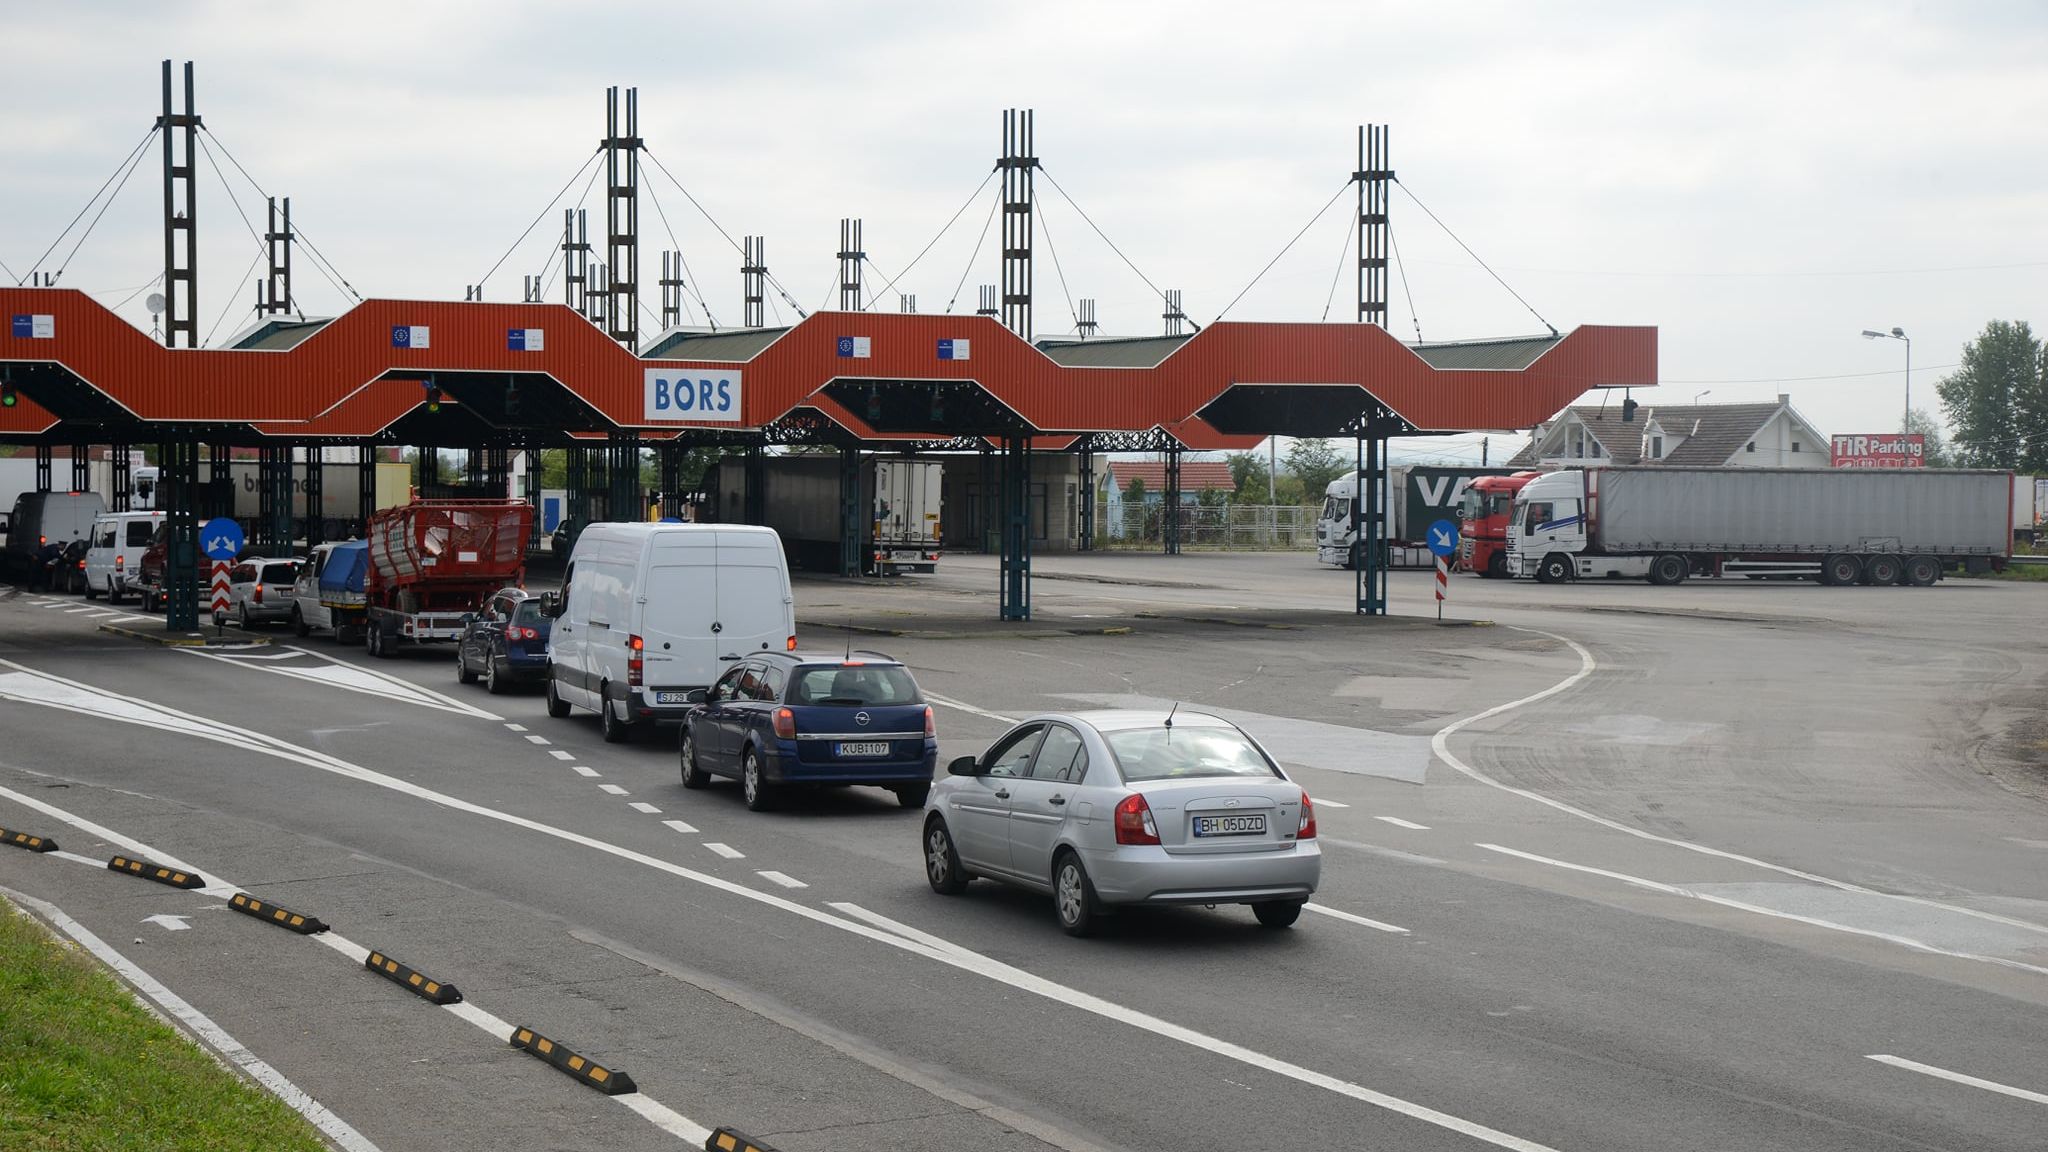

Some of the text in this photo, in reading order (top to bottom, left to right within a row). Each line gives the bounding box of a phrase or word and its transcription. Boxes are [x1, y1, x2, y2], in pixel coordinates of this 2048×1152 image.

[655, 378, 731, 412] BORS
[1833, 436, 1923, 457] TIR Parking
[1201, 816, 1264, 832] BH 05DZD
